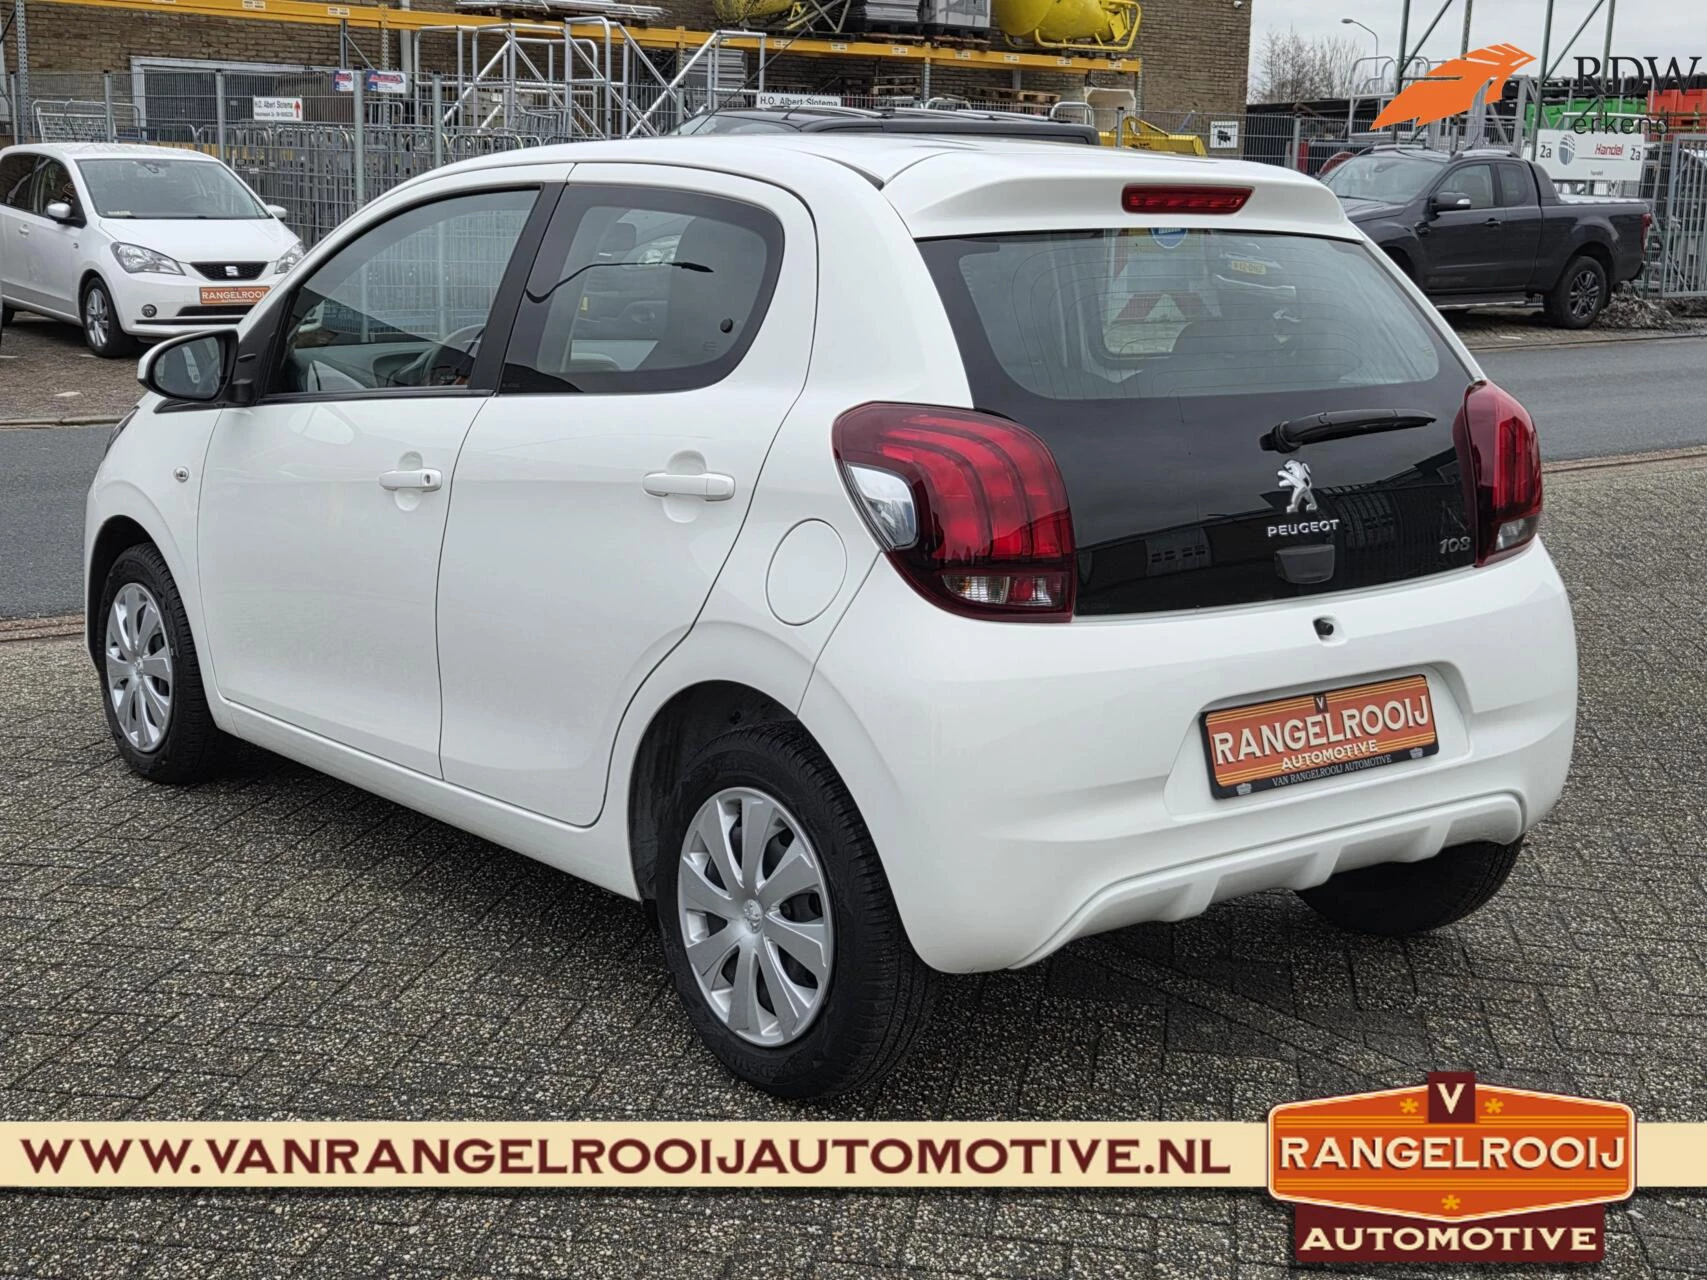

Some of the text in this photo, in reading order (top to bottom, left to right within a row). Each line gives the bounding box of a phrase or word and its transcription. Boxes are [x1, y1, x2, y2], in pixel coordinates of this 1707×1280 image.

[760, 96, 777, 105] H.O.
[780, 97, 803, 106] Albert
[1540, 144, 1552, 158] 2a
[1594, 143, 1625, 157] Handel
[1630, 147, 1641, 160] 2a
[202, 290, 266, 299] RANGELROOI
[1267, 519, 1340, 537] PEUGEOT
[1439, 536, 1471, 554] 108
[1316, 696, 1325, 710] V
[1212, 695, 1429, 765] RANGELROOIJ
[1281, 739, 1378, 771] AUTOMOTIVE
[1272, 754, 1392, 787] VAN RANGELROOIJ AUTOMOTIVE
